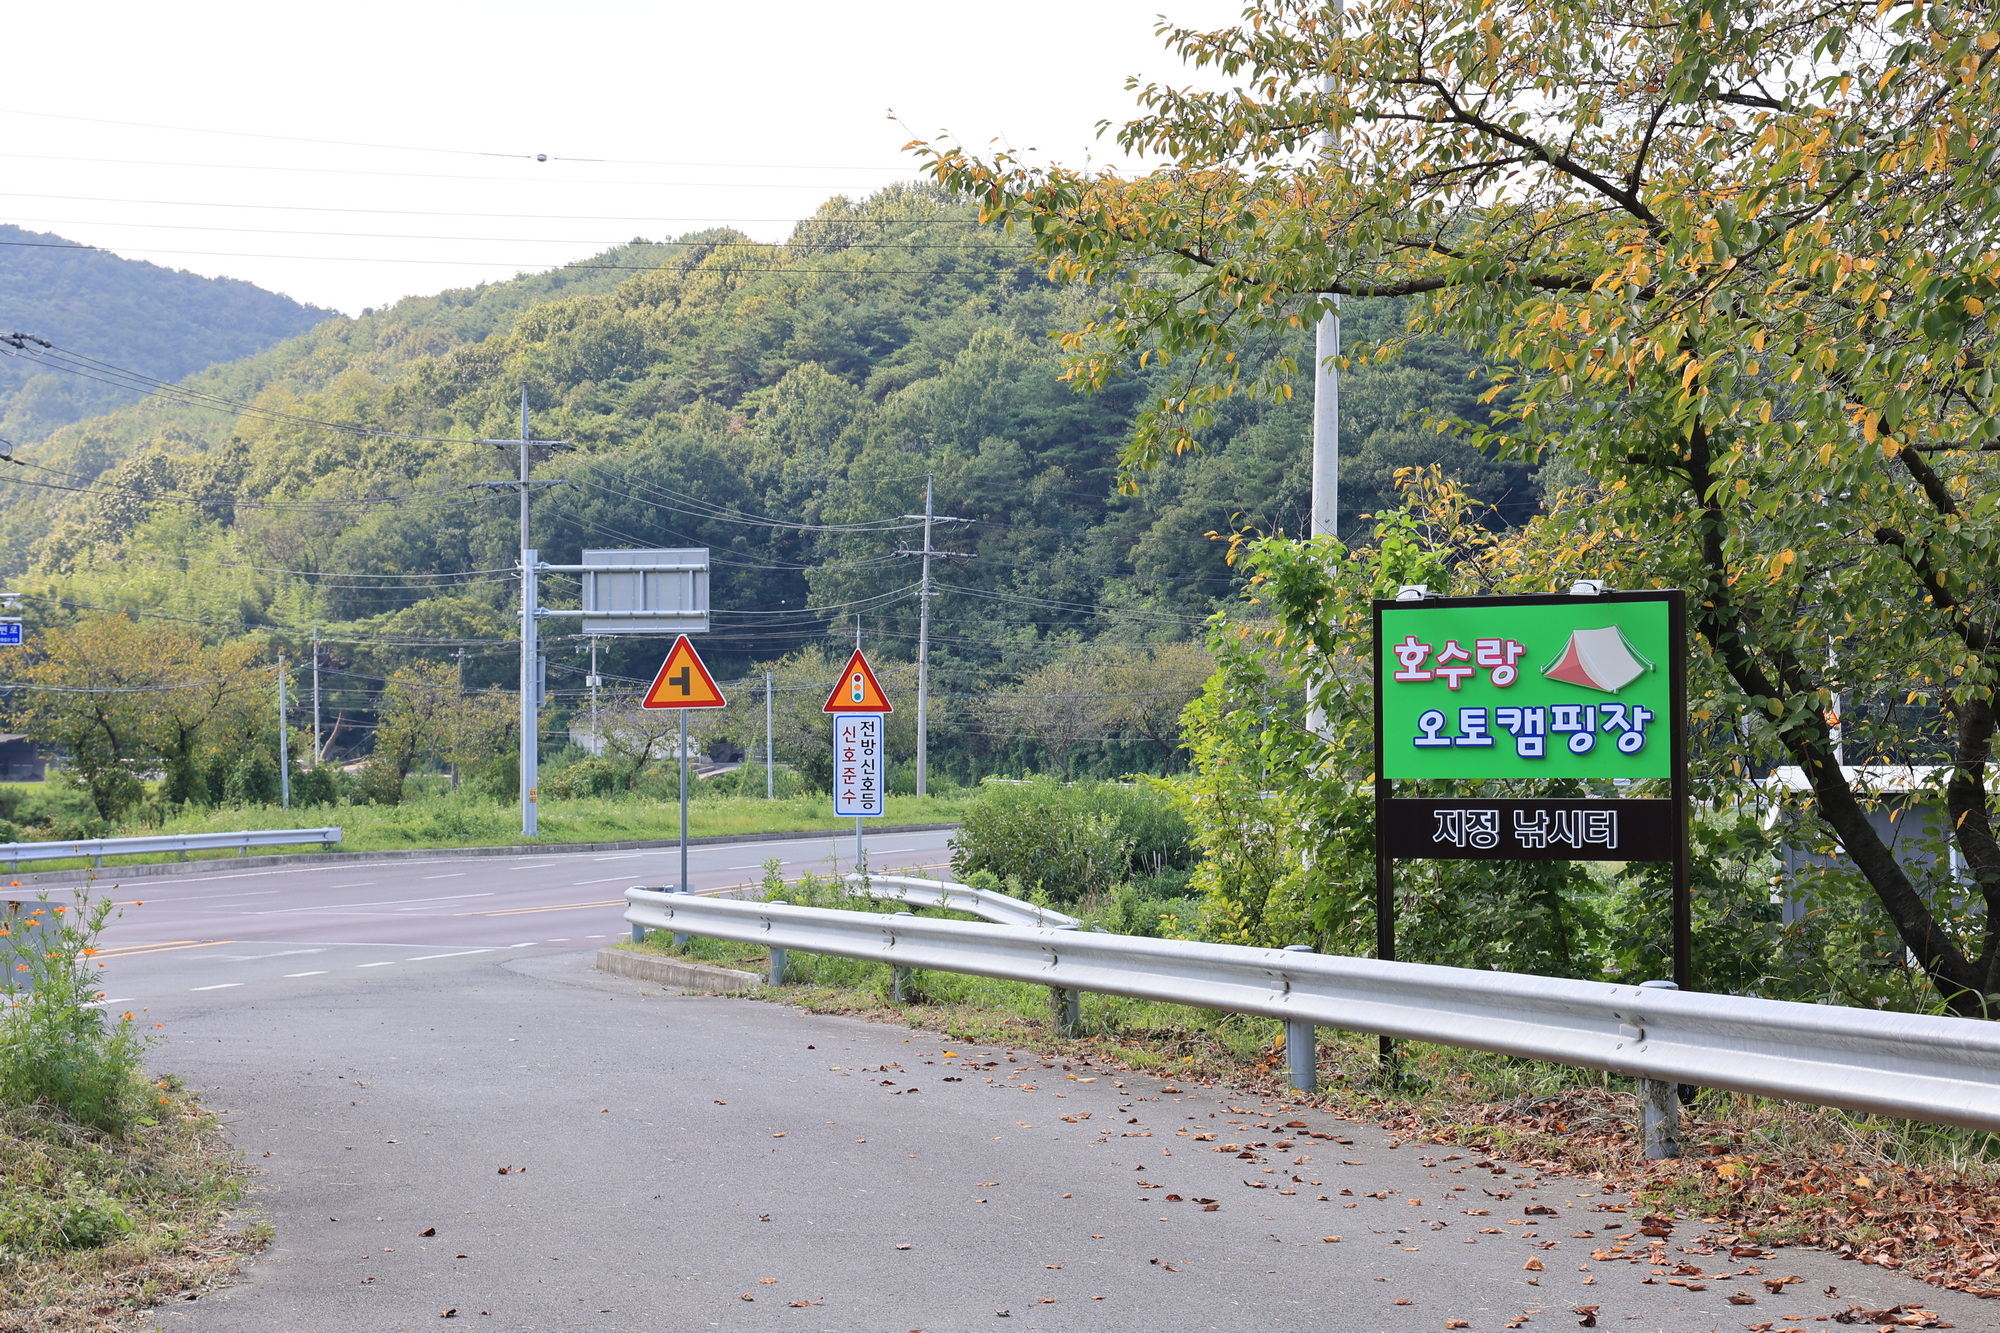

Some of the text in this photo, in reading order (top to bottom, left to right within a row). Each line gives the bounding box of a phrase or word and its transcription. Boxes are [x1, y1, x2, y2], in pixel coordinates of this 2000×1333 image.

[1393, 635, 1525, 690] 호수랑
[1413, 703, 1654, 758] 오토캠핑장
[842, 726, 857, 804] 신호준수
[860, 721, 876, 810] 전방신호등
[1432, 809, 1618, 849] 지정 낚시터
